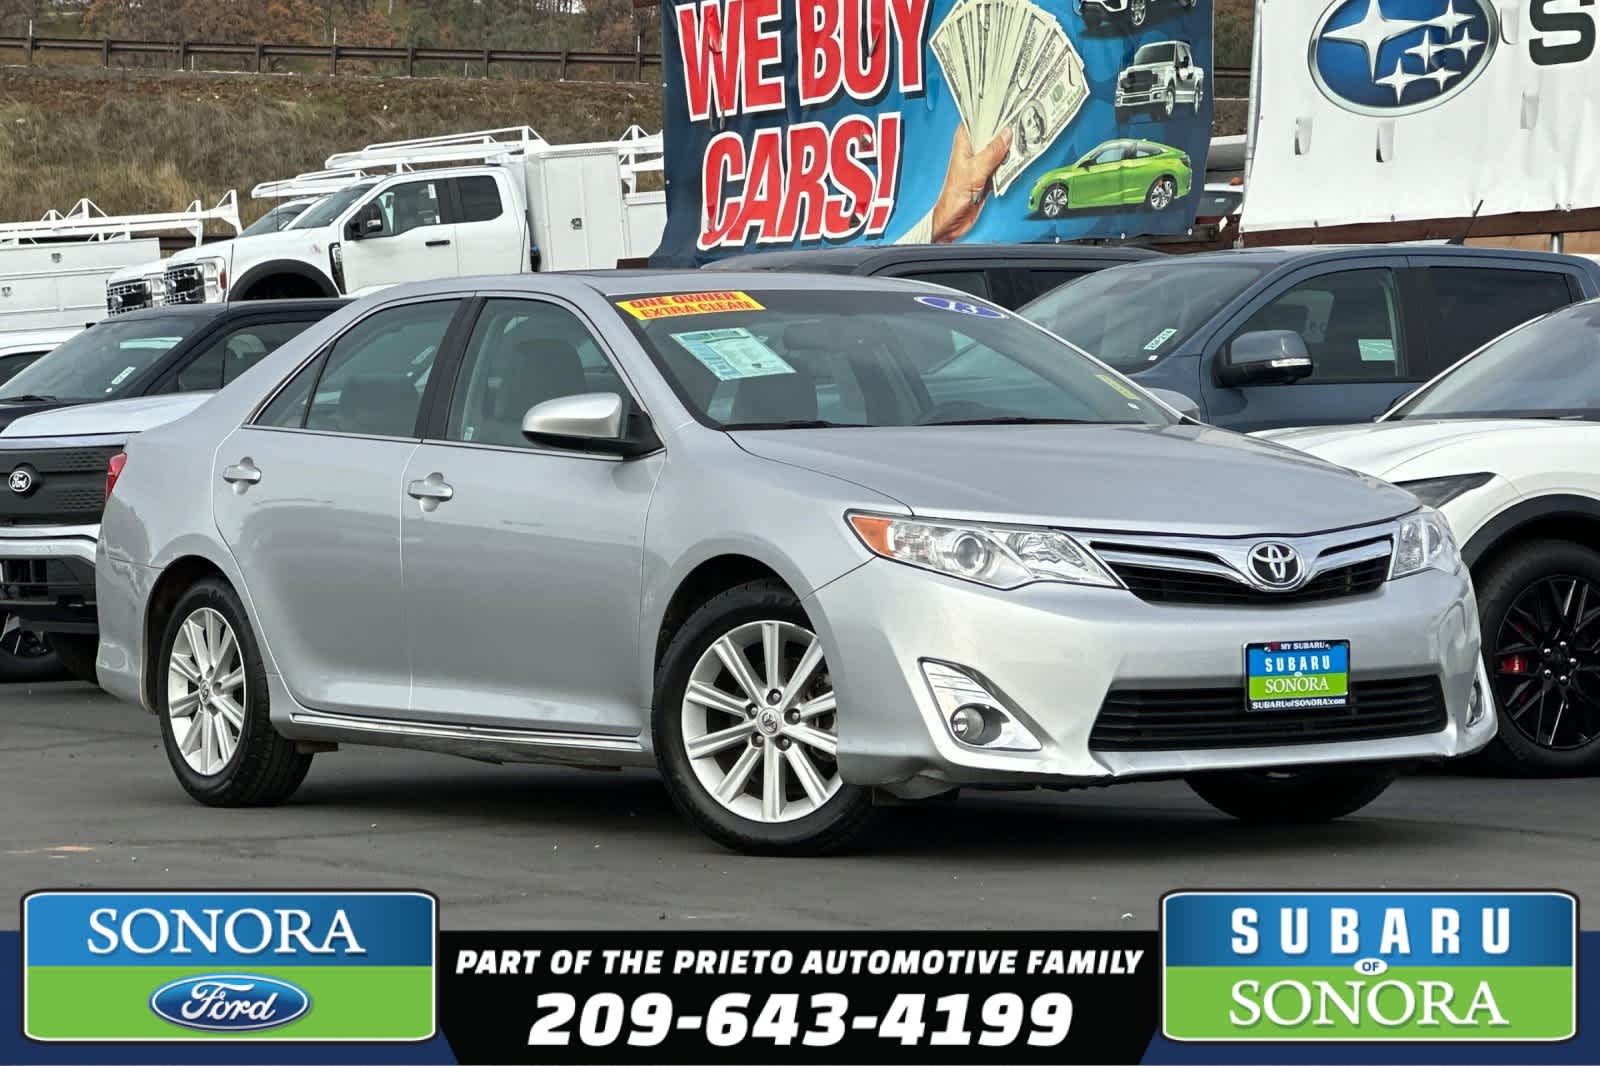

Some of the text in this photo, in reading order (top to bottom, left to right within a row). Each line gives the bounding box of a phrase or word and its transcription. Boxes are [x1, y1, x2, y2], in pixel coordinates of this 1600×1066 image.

[675, 0, 929, 121] WE BUY
[697, 111, 901, 250] CARS!
[630, 292, 737, 308] ONE OWNER
[640, 301, 755, 317] EXTRA CLEAN
[1280, 641, 1325, 650] MY SUBARU
[1265, 655, 1330, 673] SUBARU
[1265, 676, 1328, 693] SONORA
